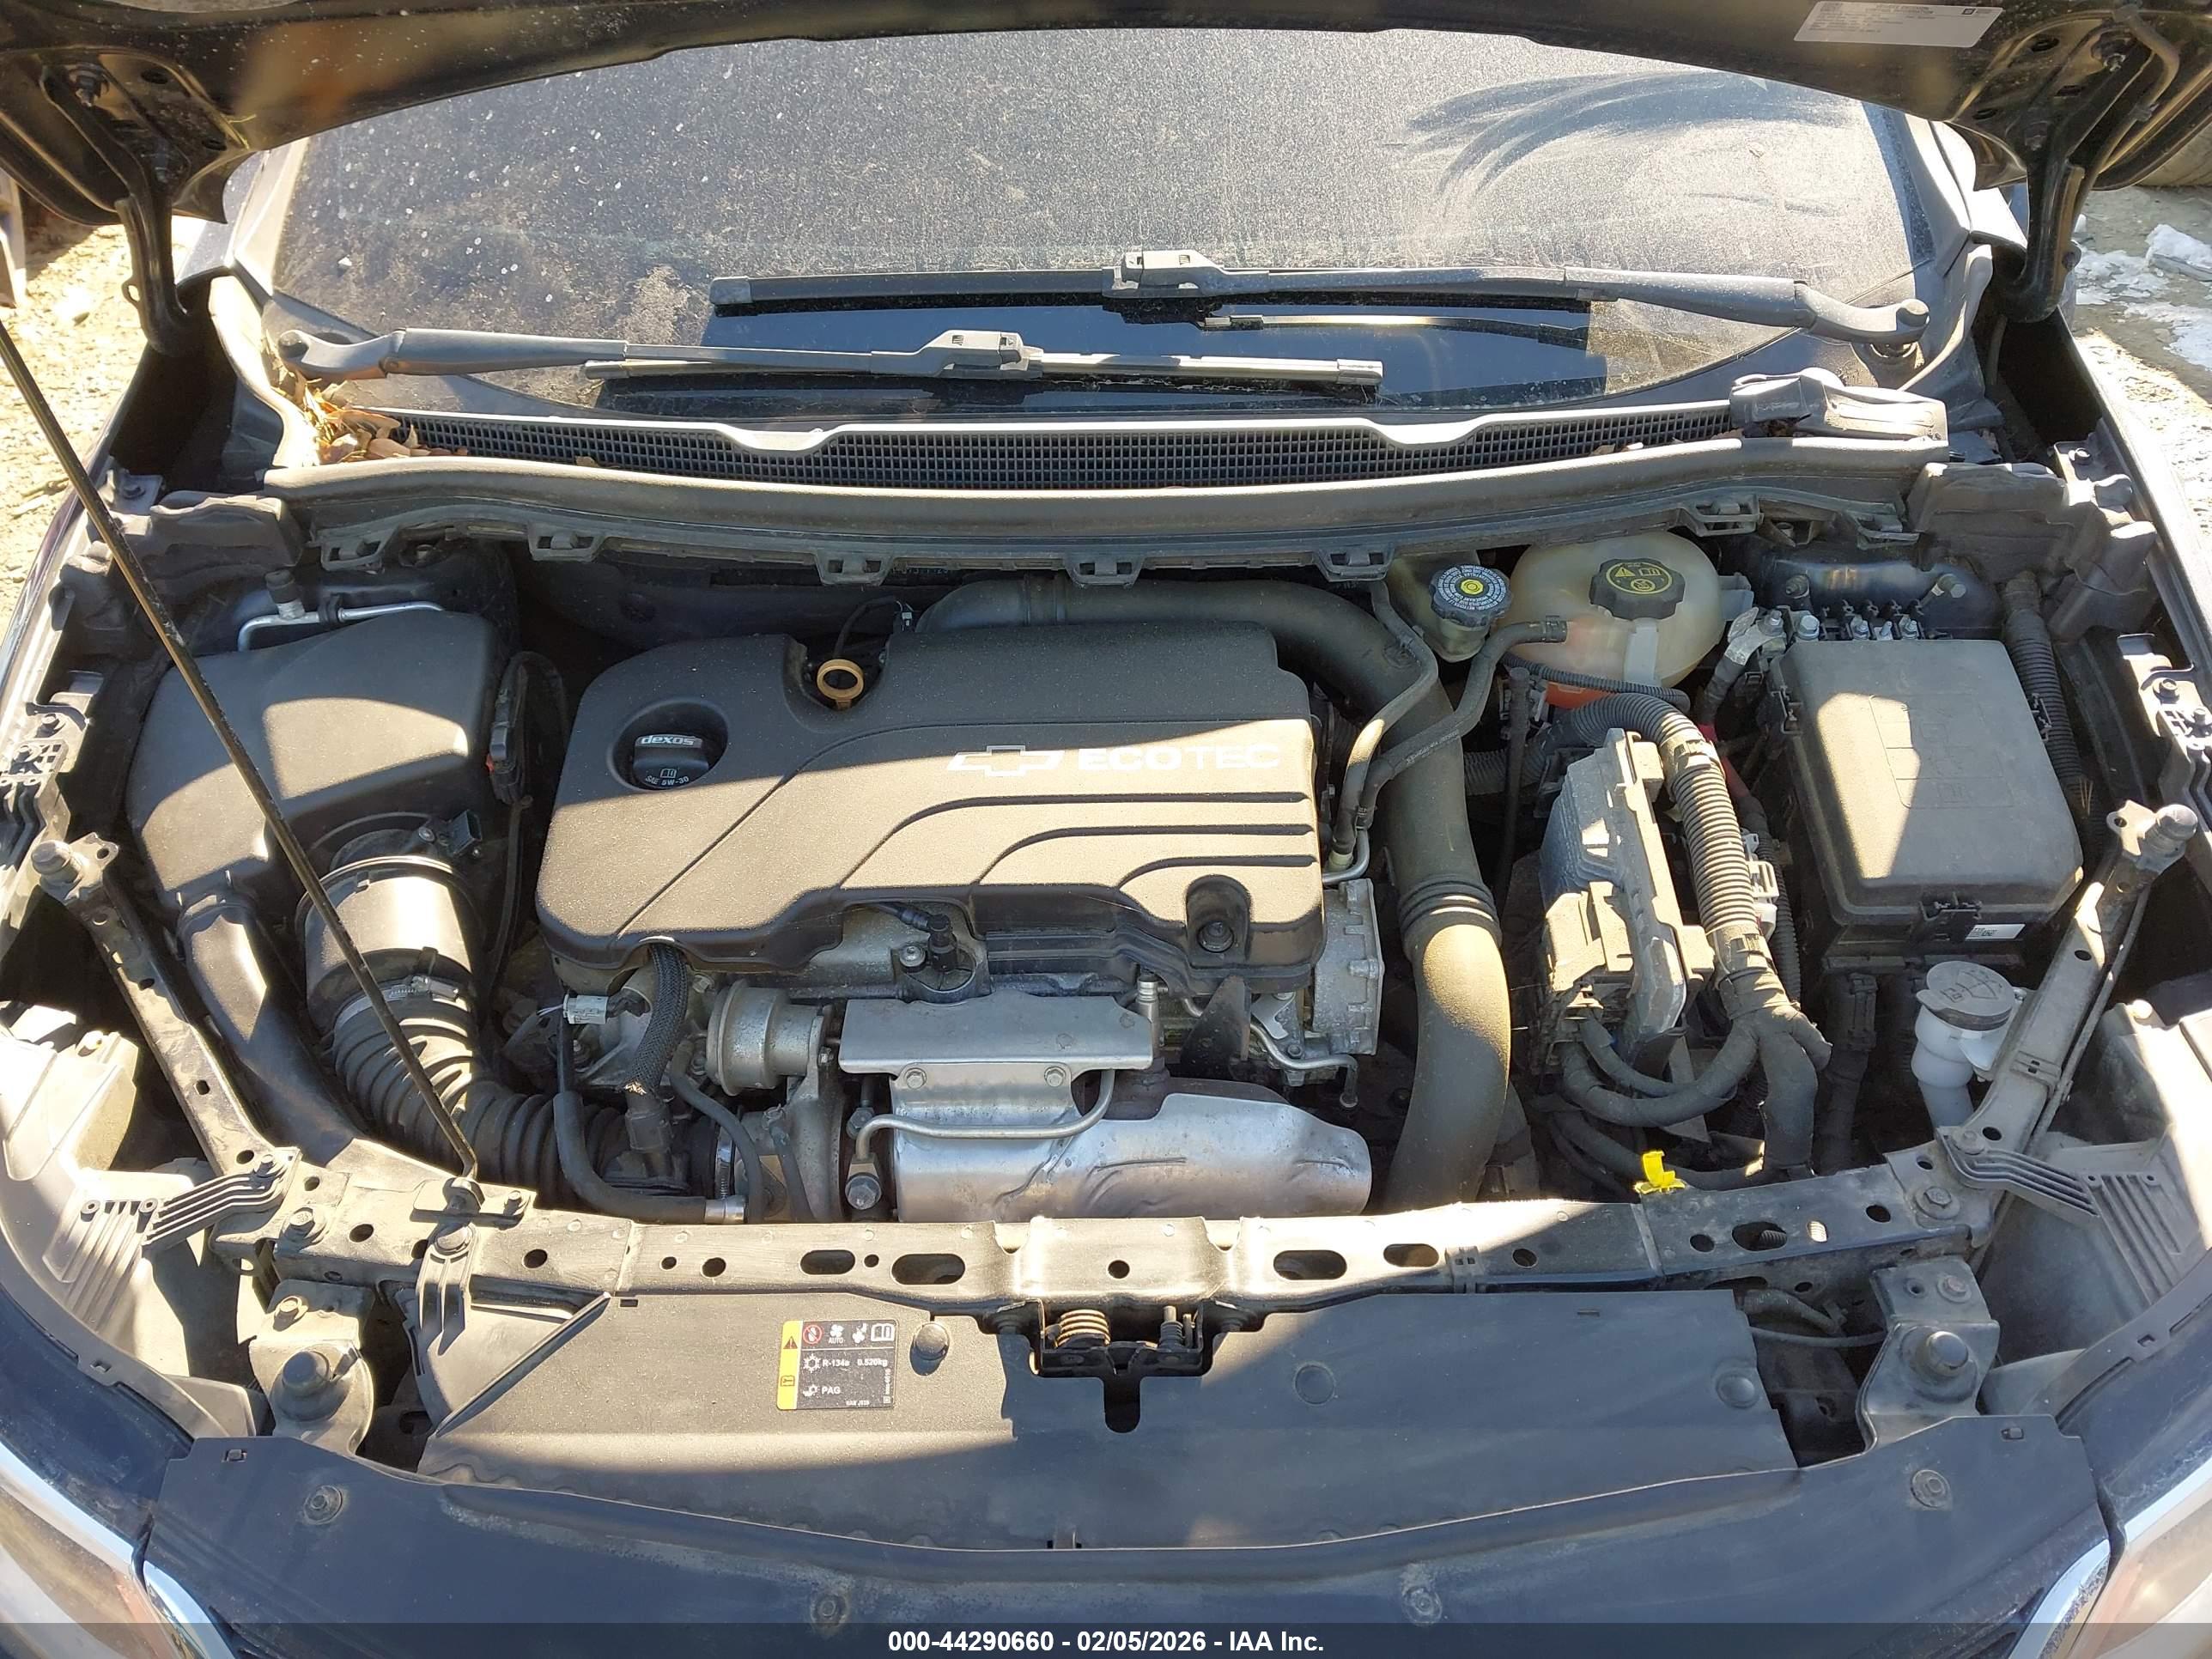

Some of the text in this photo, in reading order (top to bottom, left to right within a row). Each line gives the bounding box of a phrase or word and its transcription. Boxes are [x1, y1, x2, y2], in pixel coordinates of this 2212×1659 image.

[641, 735, 694, 745] dexos
[1078, 744, 1279, 770] ECOTEC
[645, 775, 690, 786] SAE 5W-30
[821, 1386, 842, 1395] PAG
